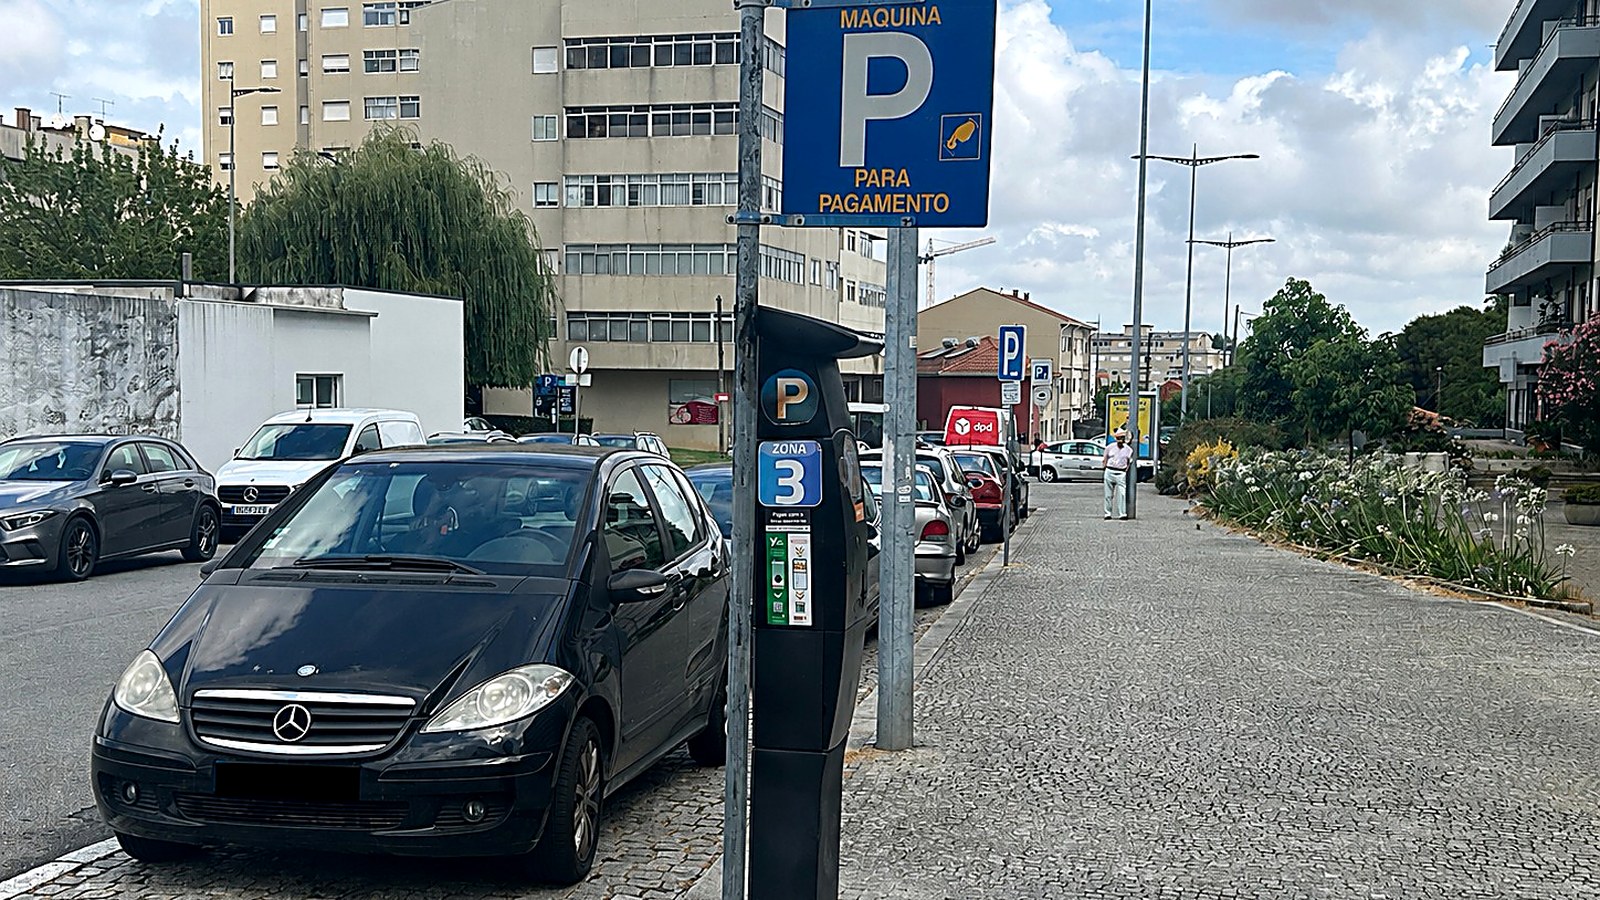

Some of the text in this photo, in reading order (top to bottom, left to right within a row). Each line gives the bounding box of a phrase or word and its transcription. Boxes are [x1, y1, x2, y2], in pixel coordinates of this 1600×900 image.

[840, 6, 941, 28] MAQUINA
[839, 31, 934, 167] P
[855, 168, 910, 188] PARA
[819, 192, 950, 214] PAGAMENTO
[1003, 331, 1020, 376] P
[544, 376, 552, 388] P
[1036, 366, 1044, 379] P
[777, 377, 809, 420] P
[973, 421, 993, 433] dpd
[772, 443, 807, 455] ZONA
[775, 459, 806, 505] 3
